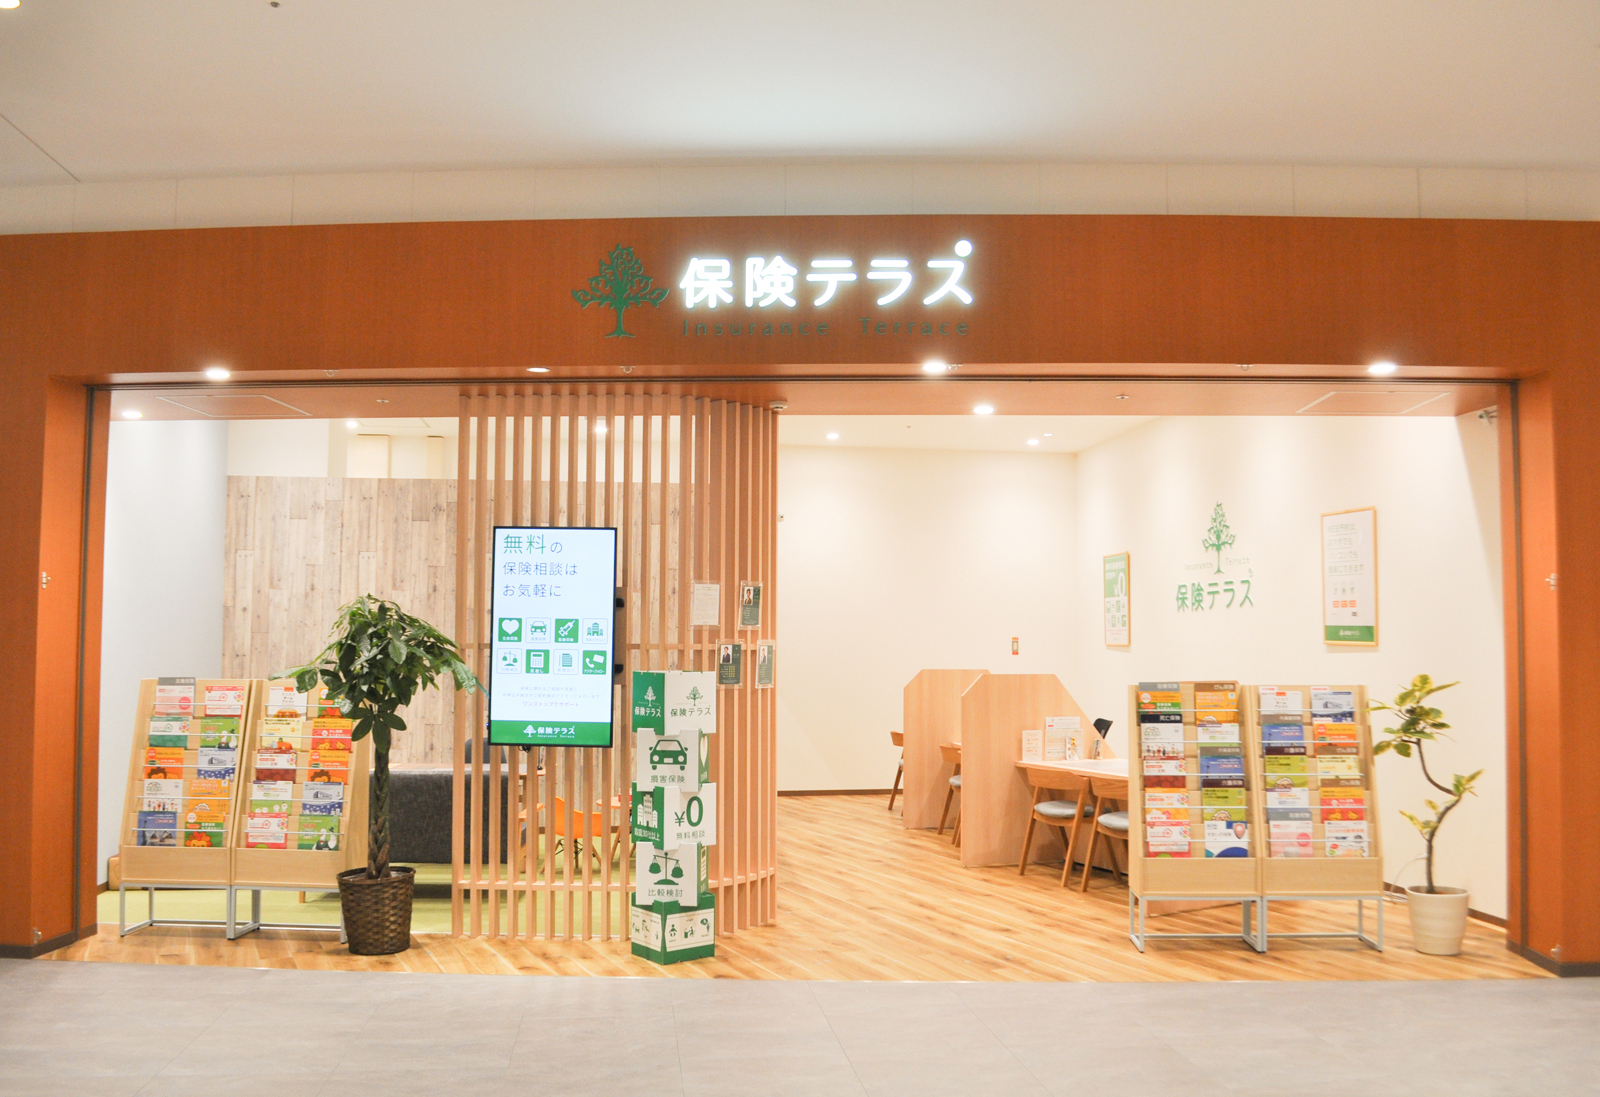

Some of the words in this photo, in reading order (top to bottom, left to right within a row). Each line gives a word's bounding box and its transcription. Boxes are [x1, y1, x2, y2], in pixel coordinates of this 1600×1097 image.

[679, 240, 973, 309] 保険テラス
[683, 319, 829, 336] Insurance
[858, 317, 969, 336] Terrace
[503, 533, 563, 555] 無料の
[502, 562, 578, 576] 保険相談は
[502, 583, 562, 598] お気軽に
[1176, 572, 1254, 612] 保険テラス
[634, 706, 661, 718] 保険テラス
[670, 705, 712, 718] 保険テラス
[537, 725, 575, 735] 保険テラス
[650, 774, 686, 784] 損害保険
[674, 796, 704, 827] ¥0
[676, 831, 706, 840] 無料相談
[648, 888, 683, 898] 比較検討
